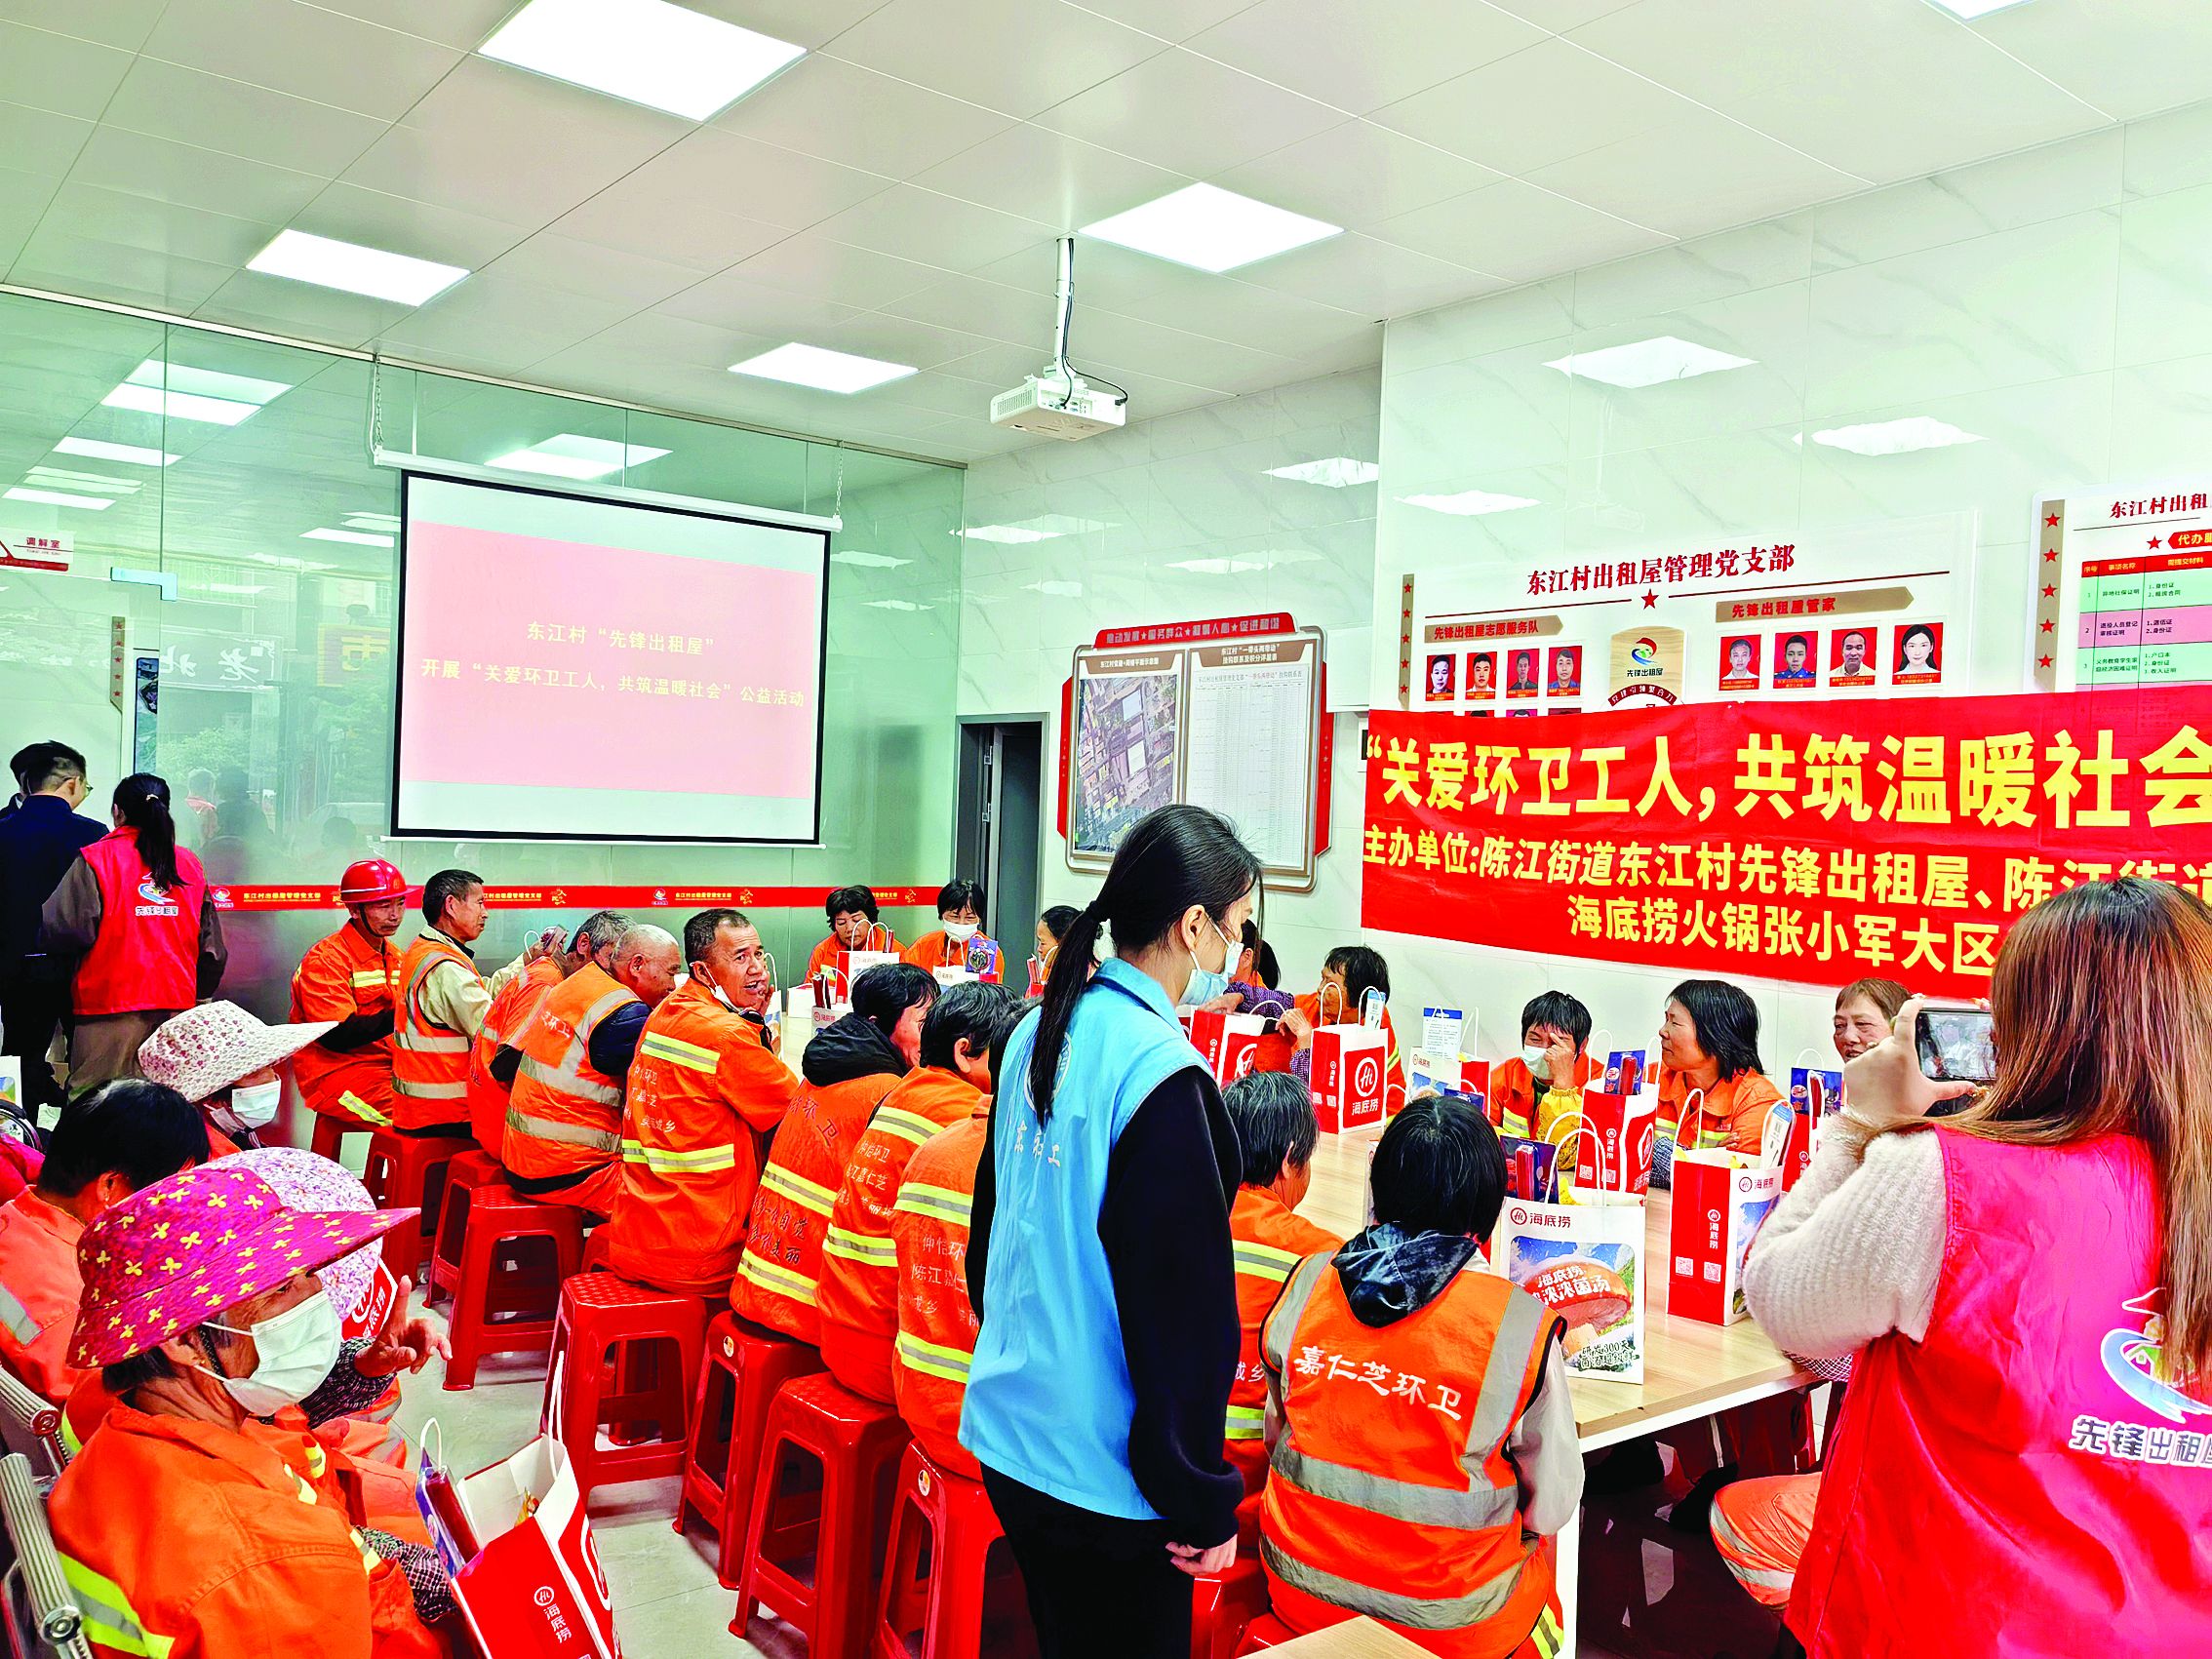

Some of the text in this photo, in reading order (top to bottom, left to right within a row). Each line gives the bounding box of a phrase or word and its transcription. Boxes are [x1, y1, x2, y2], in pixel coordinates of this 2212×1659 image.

[26, 536, 60, 549] 调解室
[1527, 543, 1796, 596] 东江村出租屋管理党支部
[1732, 597, 1837, 619] 先锋出租屋管家
[1434, 620, 1540, 641] 先锋出租屋志愿服务队
[1626, 667, 1664, 678] 先锋出租屋
[1352, 1097, 1379, 1117] 海底捞
[1529, 1212, 1571, 1229] 海底捞
[1538, 1265, 1585, 1287] 海底捞
[1293, 1345, 1462, 1421] 嘉仁芝环卫
[543, 1603, 573, 1643] 海底捞
